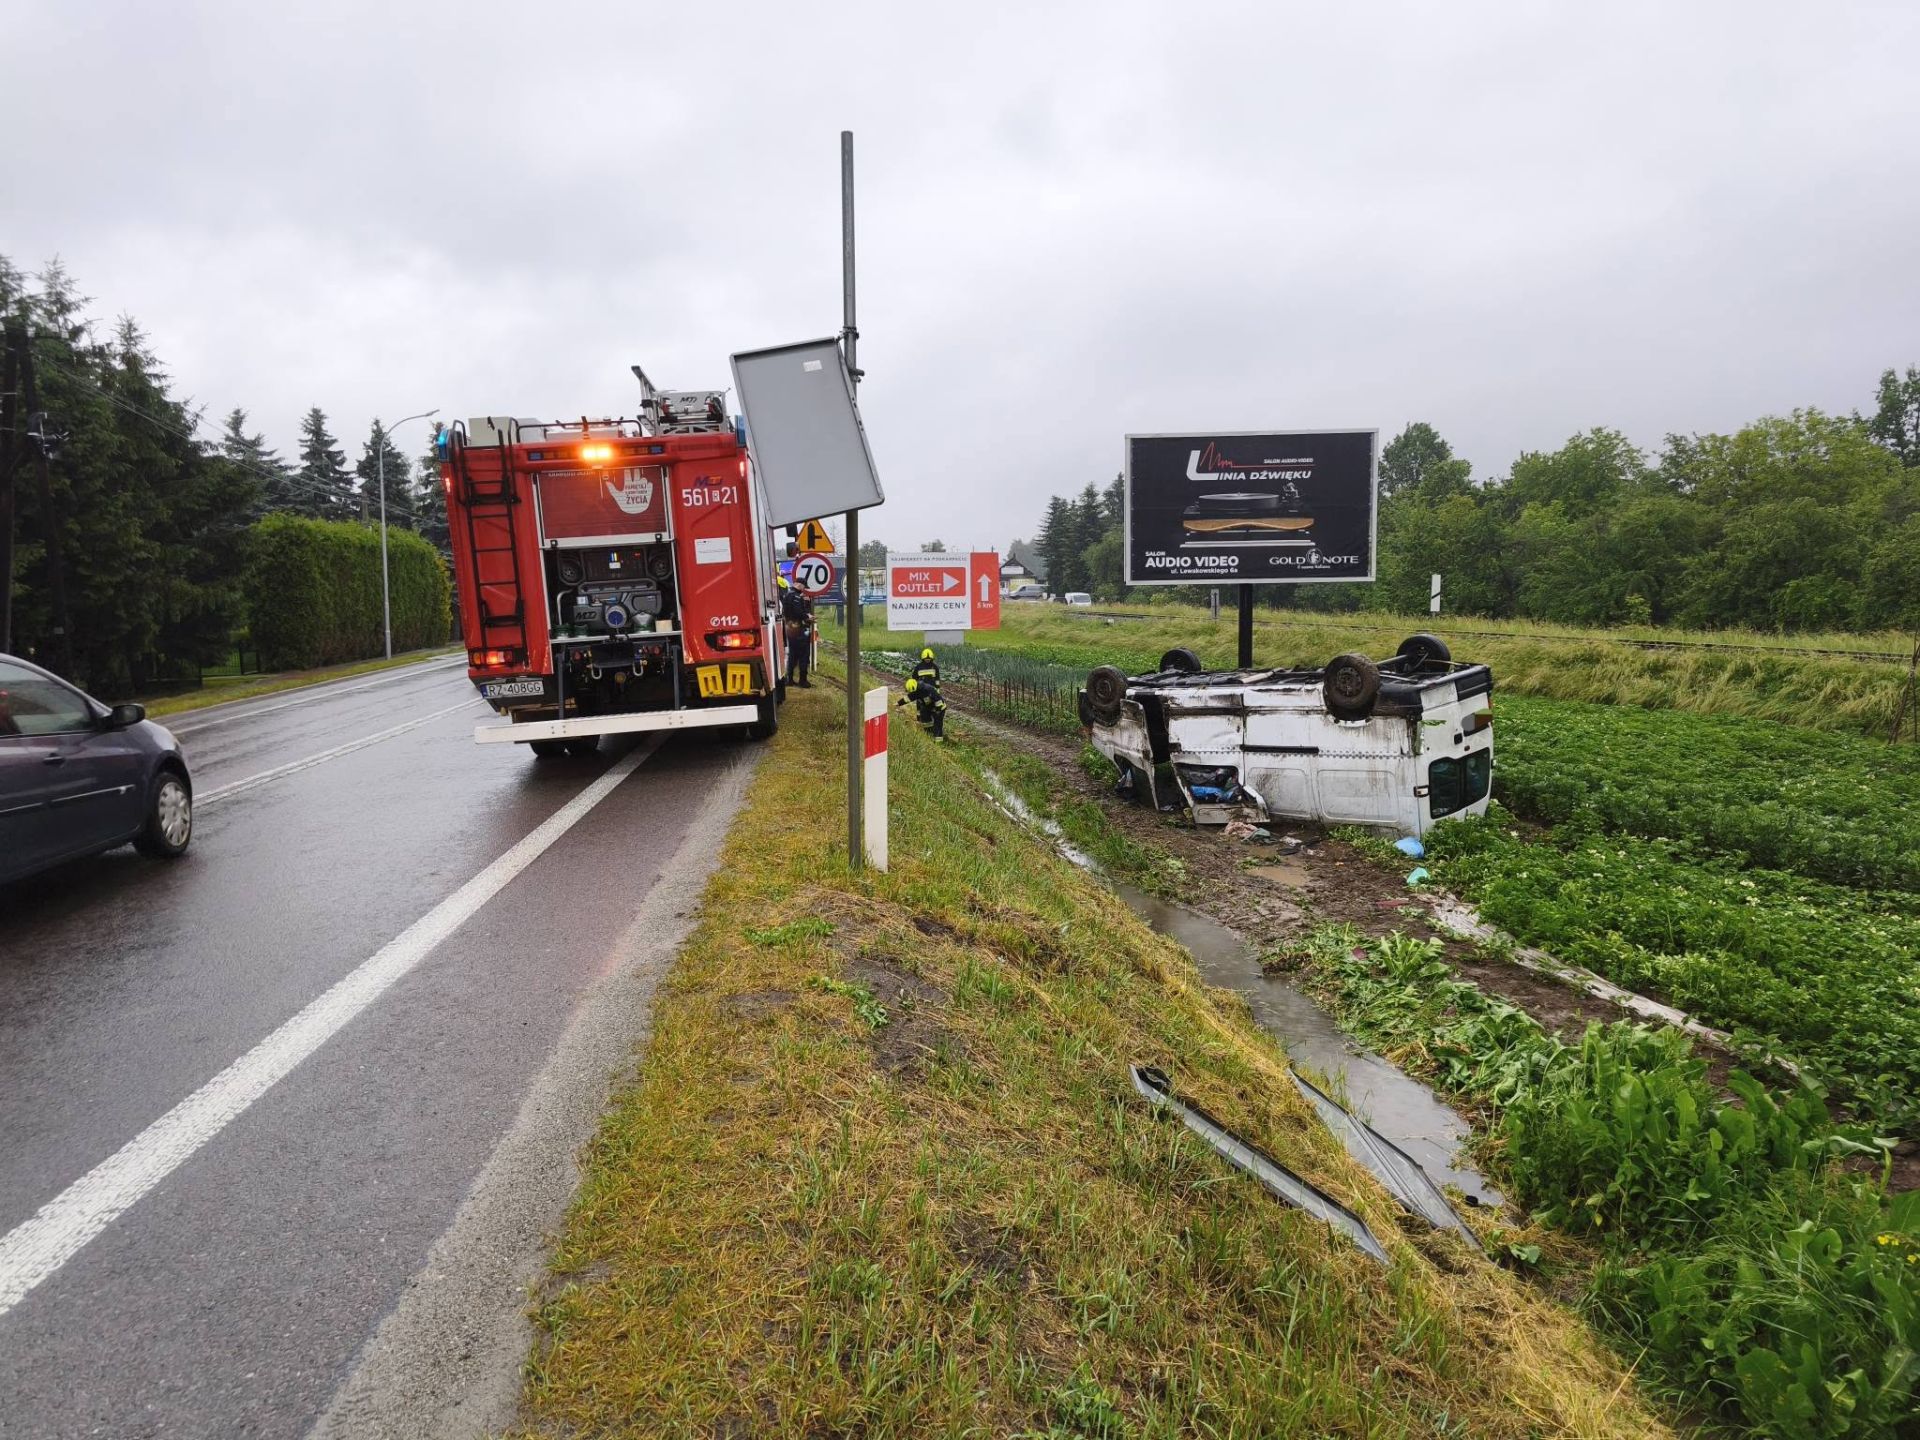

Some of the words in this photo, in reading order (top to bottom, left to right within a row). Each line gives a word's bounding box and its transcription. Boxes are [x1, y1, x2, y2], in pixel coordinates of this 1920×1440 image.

[1186, 450, 1246, 481] LINIA
[1249, 470, 1312, 480] DŹWIĘKU
[626, 494, 648, 505] ŻYCIA
[682, 487, 710, 507] 561
[721, 486, 738, 504] 21
[1145, 556, 1192, 567] AUDIO
[1194, 555, 1239, 567] VIDEO
[1269, 556, 1306, 565] GOLD
[1322, 555, 1359, 564] NOTE
[801, 564, 829, 586] 70
[909, 572, 930, 581] MIX
[897, 583, 942, 593] OUTLET
[942, 602, 967, 610] CENY
[720, 615, 740, 627] 112
